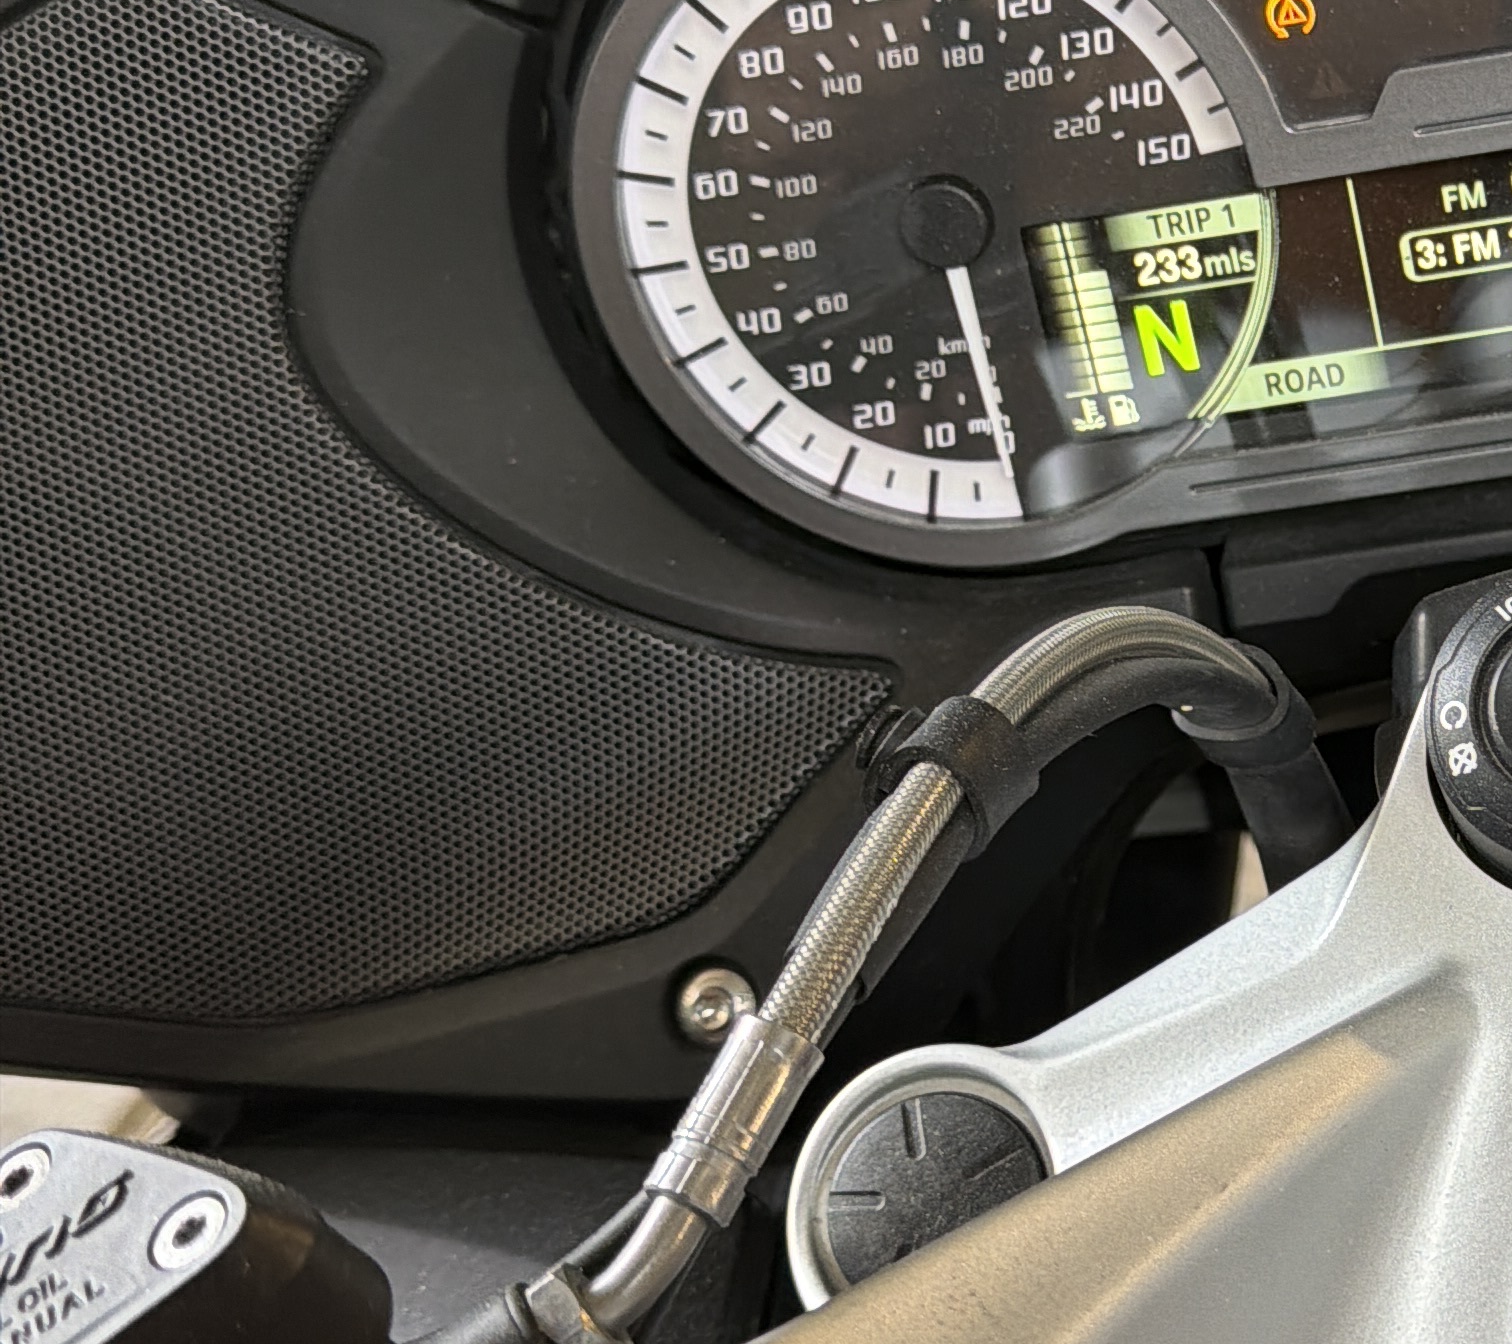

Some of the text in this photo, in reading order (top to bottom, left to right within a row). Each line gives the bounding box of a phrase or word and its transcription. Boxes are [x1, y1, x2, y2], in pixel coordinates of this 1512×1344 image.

[786, 1, 832, 34] 90
[876, 44, 919, 70] 160
[942, 43, 984, 68] 180
[1061, 27, 1114, 60] 130
[738, 46, 785, 78] 80
[820, 73, 862, 98] 140
[1004, 66, 1053, 91] 200
[1110, 79, 1163, 112] 140
[705, 106, 748, 137] 70
[790, 118, 832, 142] 120
[1054, 115, 1100, 139] 220
[1137, 133, 1191, 166] 150
[694, 169, 739, 200] 60
[775, 173, 817, 199] 100
[1442, 181, 1486, 213] FM
[1147, 204, 1236, 240] TRIP 1
[705, 243, 750, 273] 50
[782, 238, 817, 261] 80
[1415, 236, 1446, 269] 3:
[1454, 227, 1500, 265] FM
[1134, 245, 1255, 288] 233 mls
[815, 292, 848, 314] 60
[737, 307, 782, 335] 40
[859, 334, 893, 356] 40
[937, 335, 991, 355] km
[1134, 300, 1201, 377] N
[787, 361, 831, 390] 30
[915, 359, 946, 380] 20
[1265, 363, 1345, 397] ROAD
[853, 400, 895, 429] 20
[924, 422, 956, 449] 10
[17, 1273, 68, 1313] OIL
